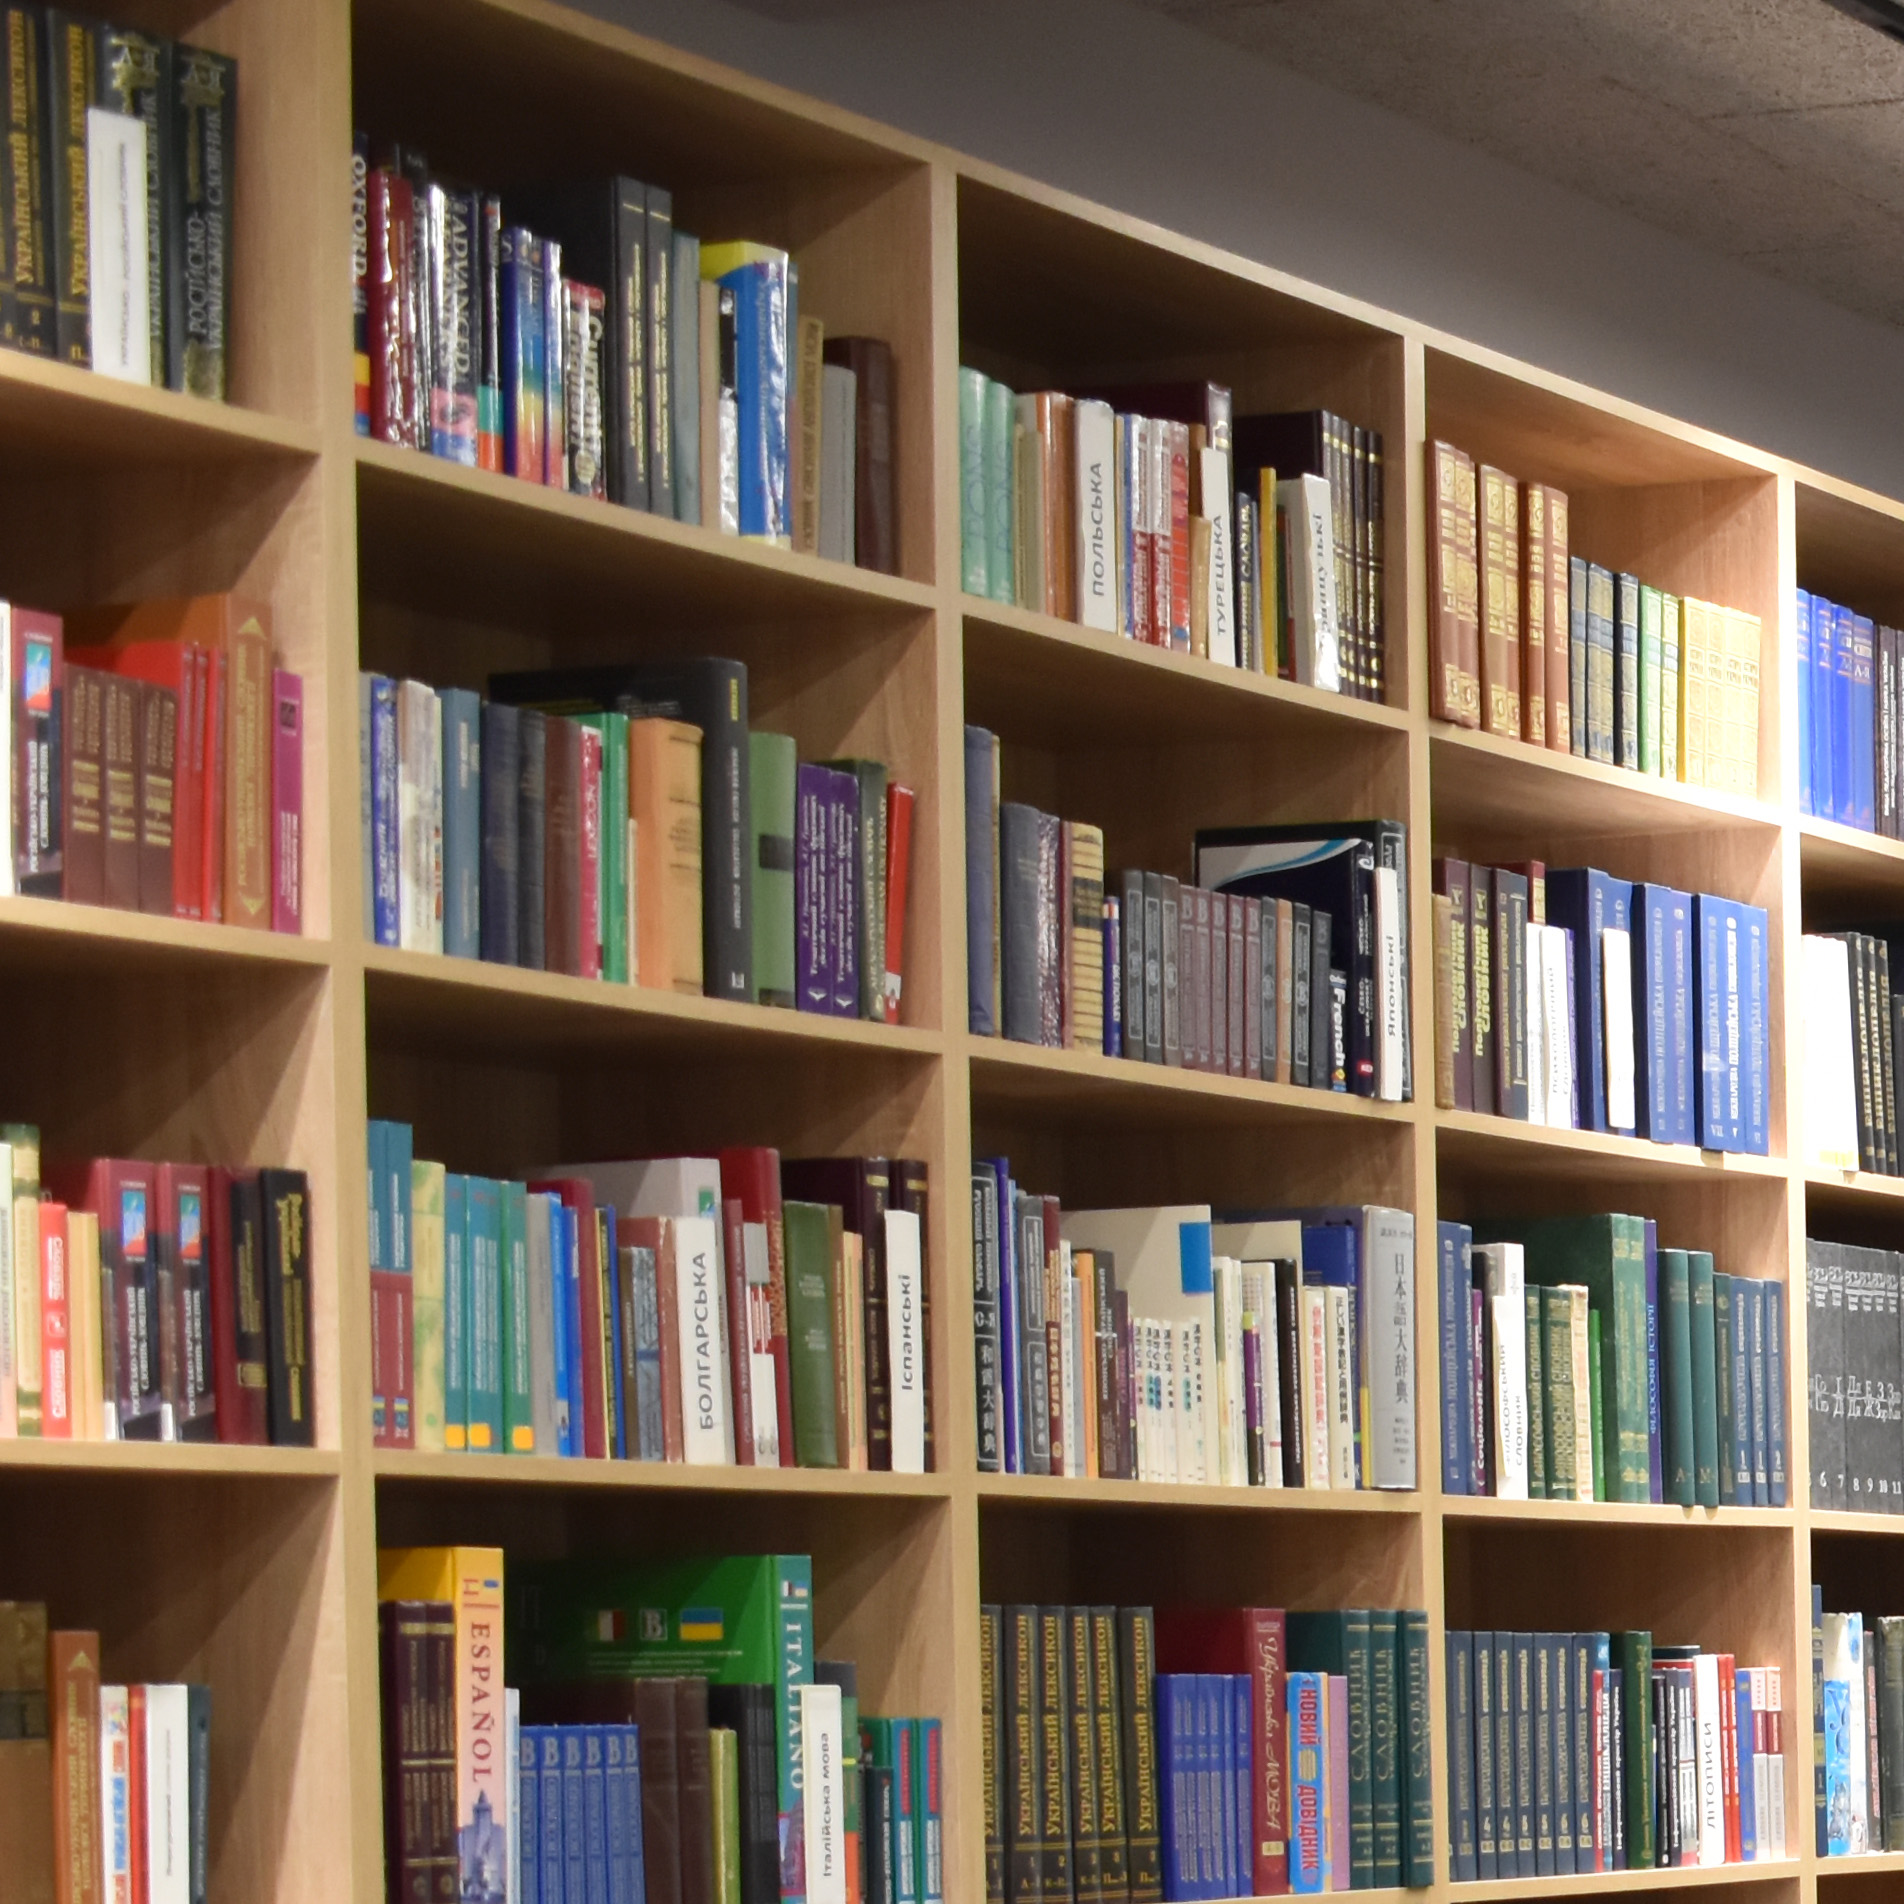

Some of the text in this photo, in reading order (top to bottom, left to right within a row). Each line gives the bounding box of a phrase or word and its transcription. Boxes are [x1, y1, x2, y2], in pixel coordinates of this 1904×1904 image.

[352, 154, 368, 277] OXFORD
[1089, 461, 1105, 596] ПОЛЬСЬКА
[1212, 514, 1227, 636] ТУРЕЦЬКА
[1334, 987, 1347, 1068] French
[1386, 936, 1397, 1038] Японські
[691, 1253, 714, 1430] БОЛГАРСЬКА
[896, 1275, 914, 1391] Іспанські
[1393, 1252, 1409, 1404] 日本語大辞典
[1648, 1358, 1657, 1434] ФІЛОСОФІЯ
[470, 1621, 496, 1782] ESPAÑOL
[785, 1622, 805, 1790] ITALIANO
[1016, 1615, 1032, 1836] УКРАЇНСЬКИЙ ЛЕКСИКОН
[1043, 1615, 1062, 1836] УКРАЇНСЬКИЙ ЛЕКСИКОН
[1074, 1615, 1094, 1834] УКРАЇНСЬКИЙ ЛЕКСИКОН
[1095, 1615, 1117, 1833] УКРАЇНСЬКИЙ ЛЕКСИКОН
[1133, 1616, 1153, 1832] УКРАЇНСЬКИЙ ЛЕКСИКОН
[1350, 1649, 1364, 1781] СЛОВНИК
[1375, 1649, 1389, 1781] СЛОВНИК
[1409, 1647, 1424, 1779] СЛОВНИК
[821, 1732, 834, 1878] Італійська мова
[1296, 1689, 1322, 1870] НОВИЙ ДОВІДНИК
[1702, 1722, 1716, 1829] ЛІТОПИСИ
